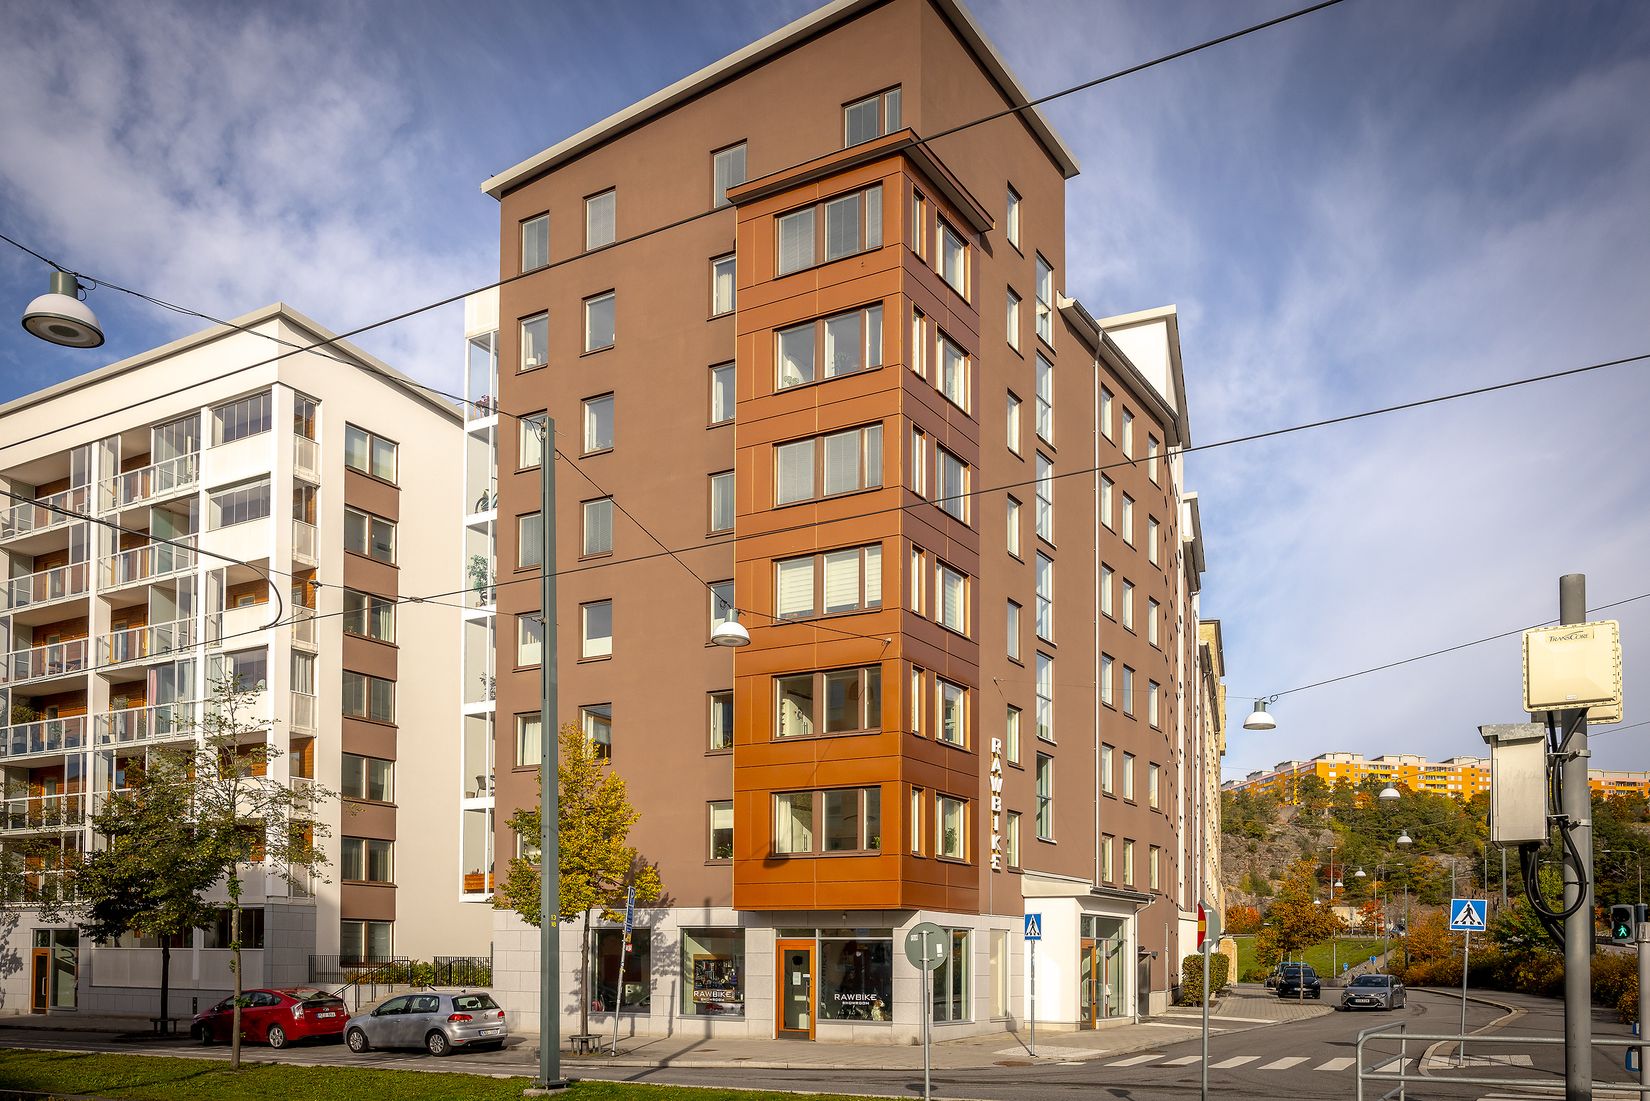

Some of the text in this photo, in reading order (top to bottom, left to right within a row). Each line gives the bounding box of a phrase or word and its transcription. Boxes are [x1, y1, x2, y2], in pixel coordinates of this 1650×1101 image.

[990, 737, 1003, 870] RAWBIKE
[693, 990, 732, 998] RAWBIKE
[834, 993, 877, 1001] RAWBIKE
